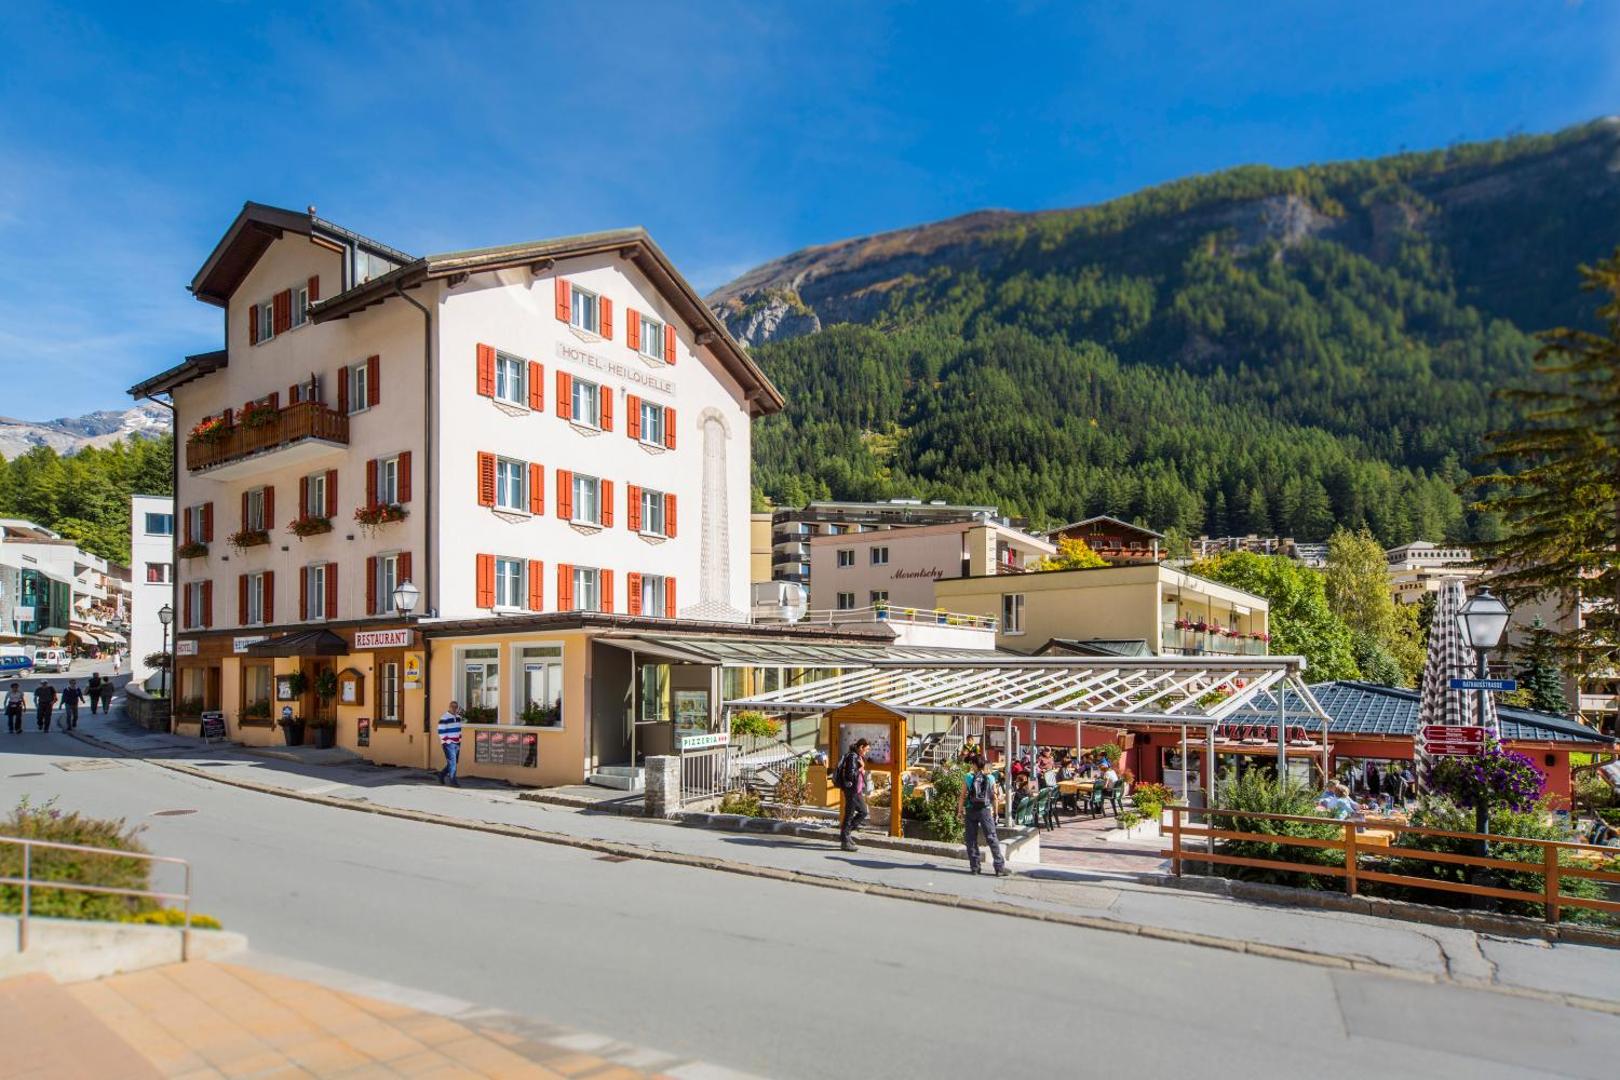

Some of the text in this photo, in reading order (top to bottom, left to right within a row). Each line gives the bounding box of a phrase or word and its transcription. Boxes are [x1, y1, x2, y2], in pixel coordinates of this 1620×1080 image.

[562, 346, 672, 393] HOTEL HEILQUELLE
[357, 632, 406, 646] RESTAURANT
[1462, 680, 1503, 689] RATHAUSSTRASSE
[1218, 724, 1310, 742] IZZERIA
[684, 736, 717, 746] PIZZERIA
